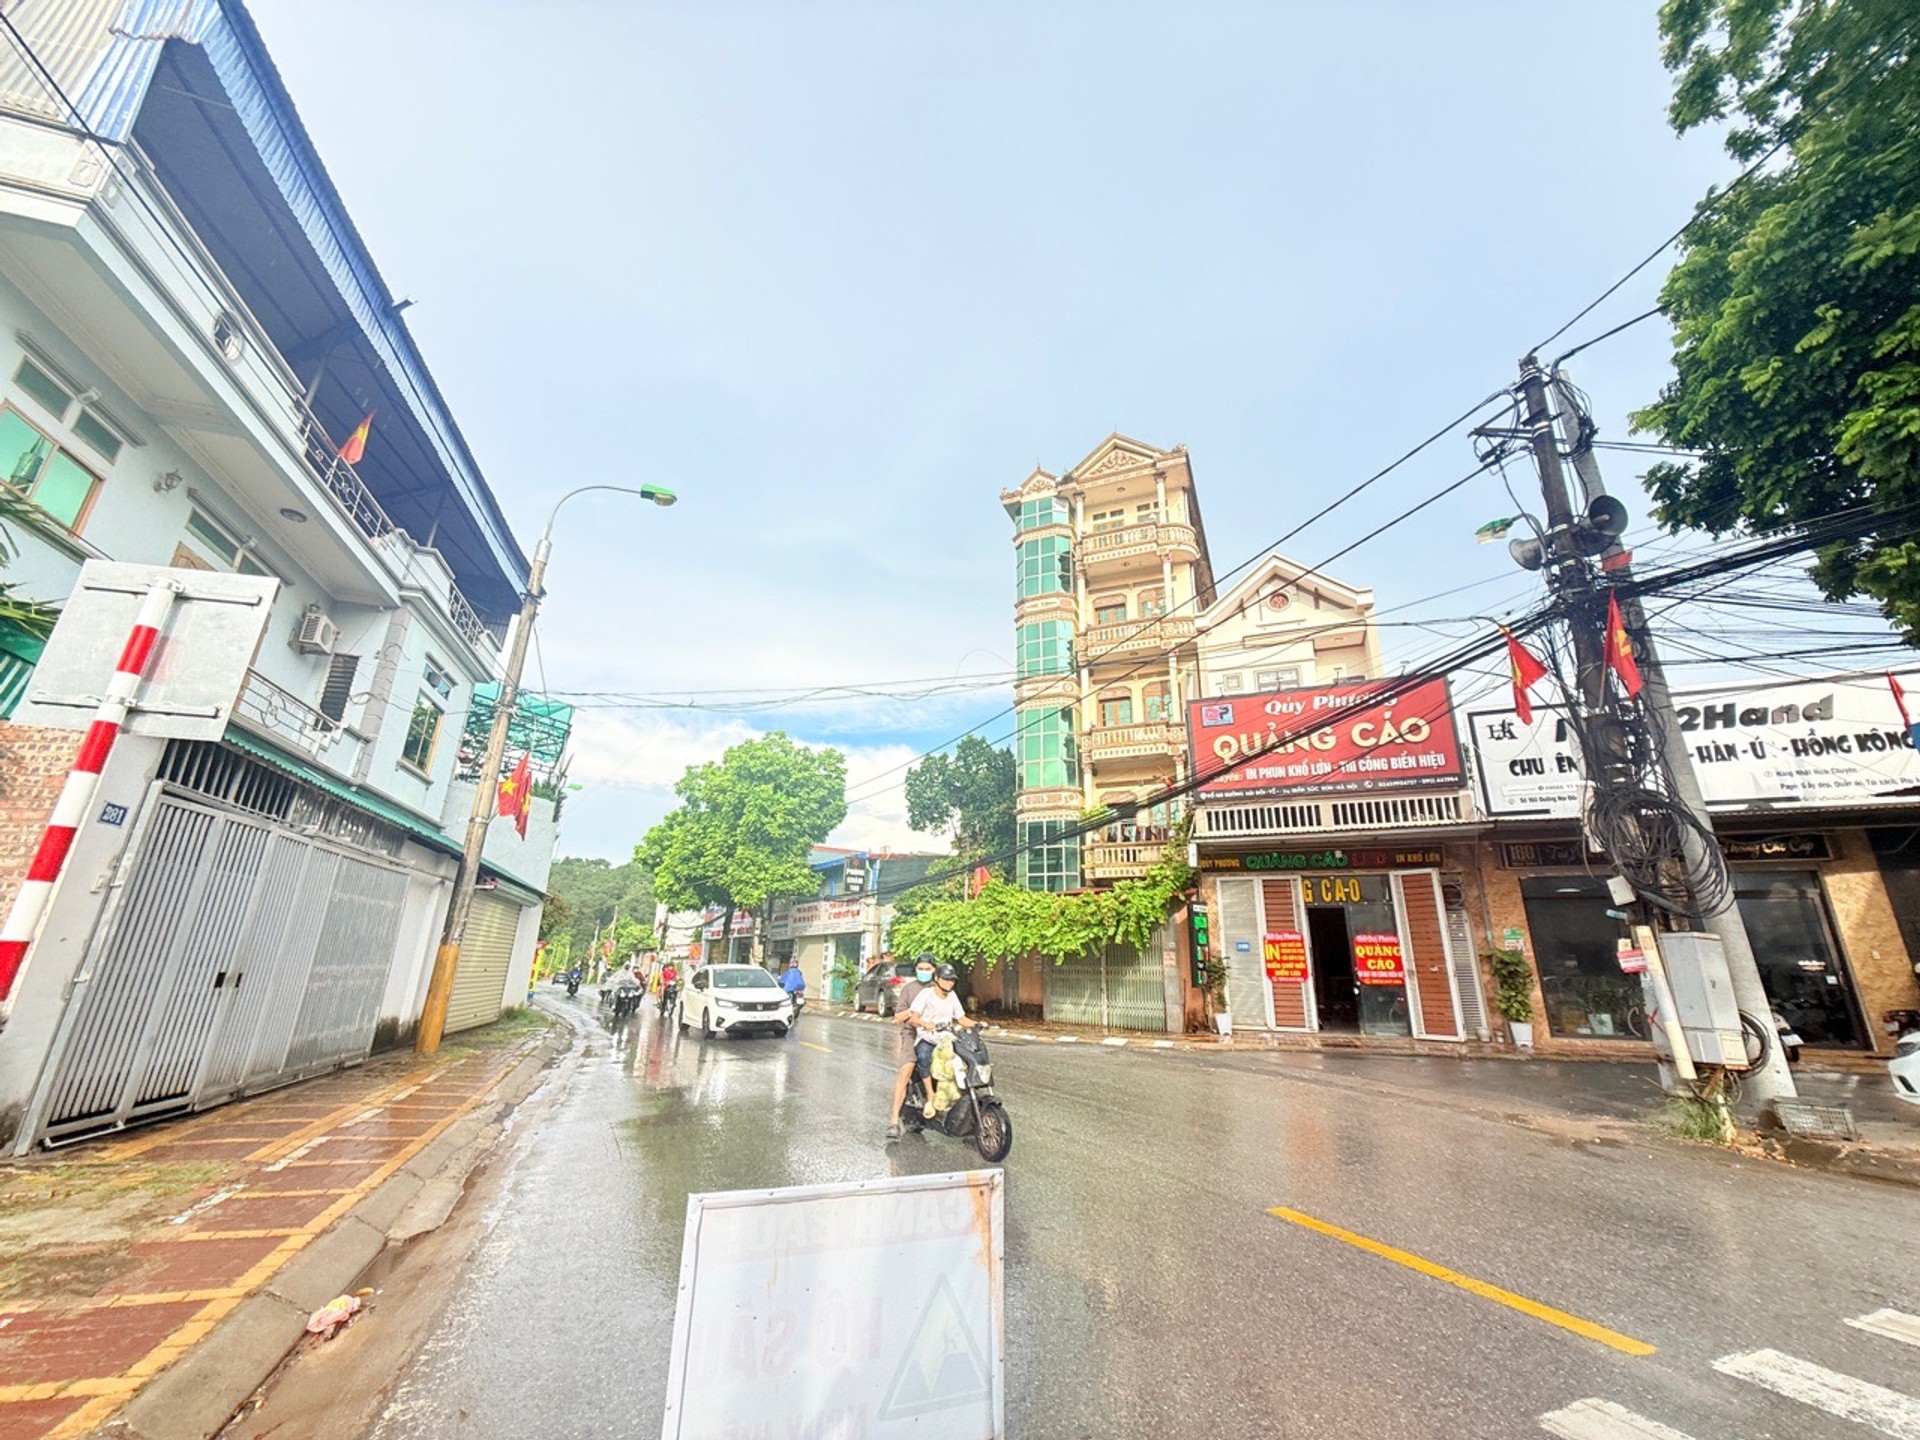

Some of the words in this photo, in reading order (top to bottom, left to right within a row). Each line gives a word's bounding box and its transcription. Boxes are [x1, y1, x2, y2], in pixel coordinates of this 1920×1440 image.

[1213, 721, 1337, 767] QUẢNG
[1351, 711, 1431, 747] CÁO
[1790, 728, 1851, 758] HỒNG
[1245, 767, 1258, 780] IN
[1260, 765, 1286, 779] PHUN
[1358, 755, 1389, 772] CÔNG
[1418, 750, 1446, 770] HIỆU
[102, 805, 125, 824] 281
